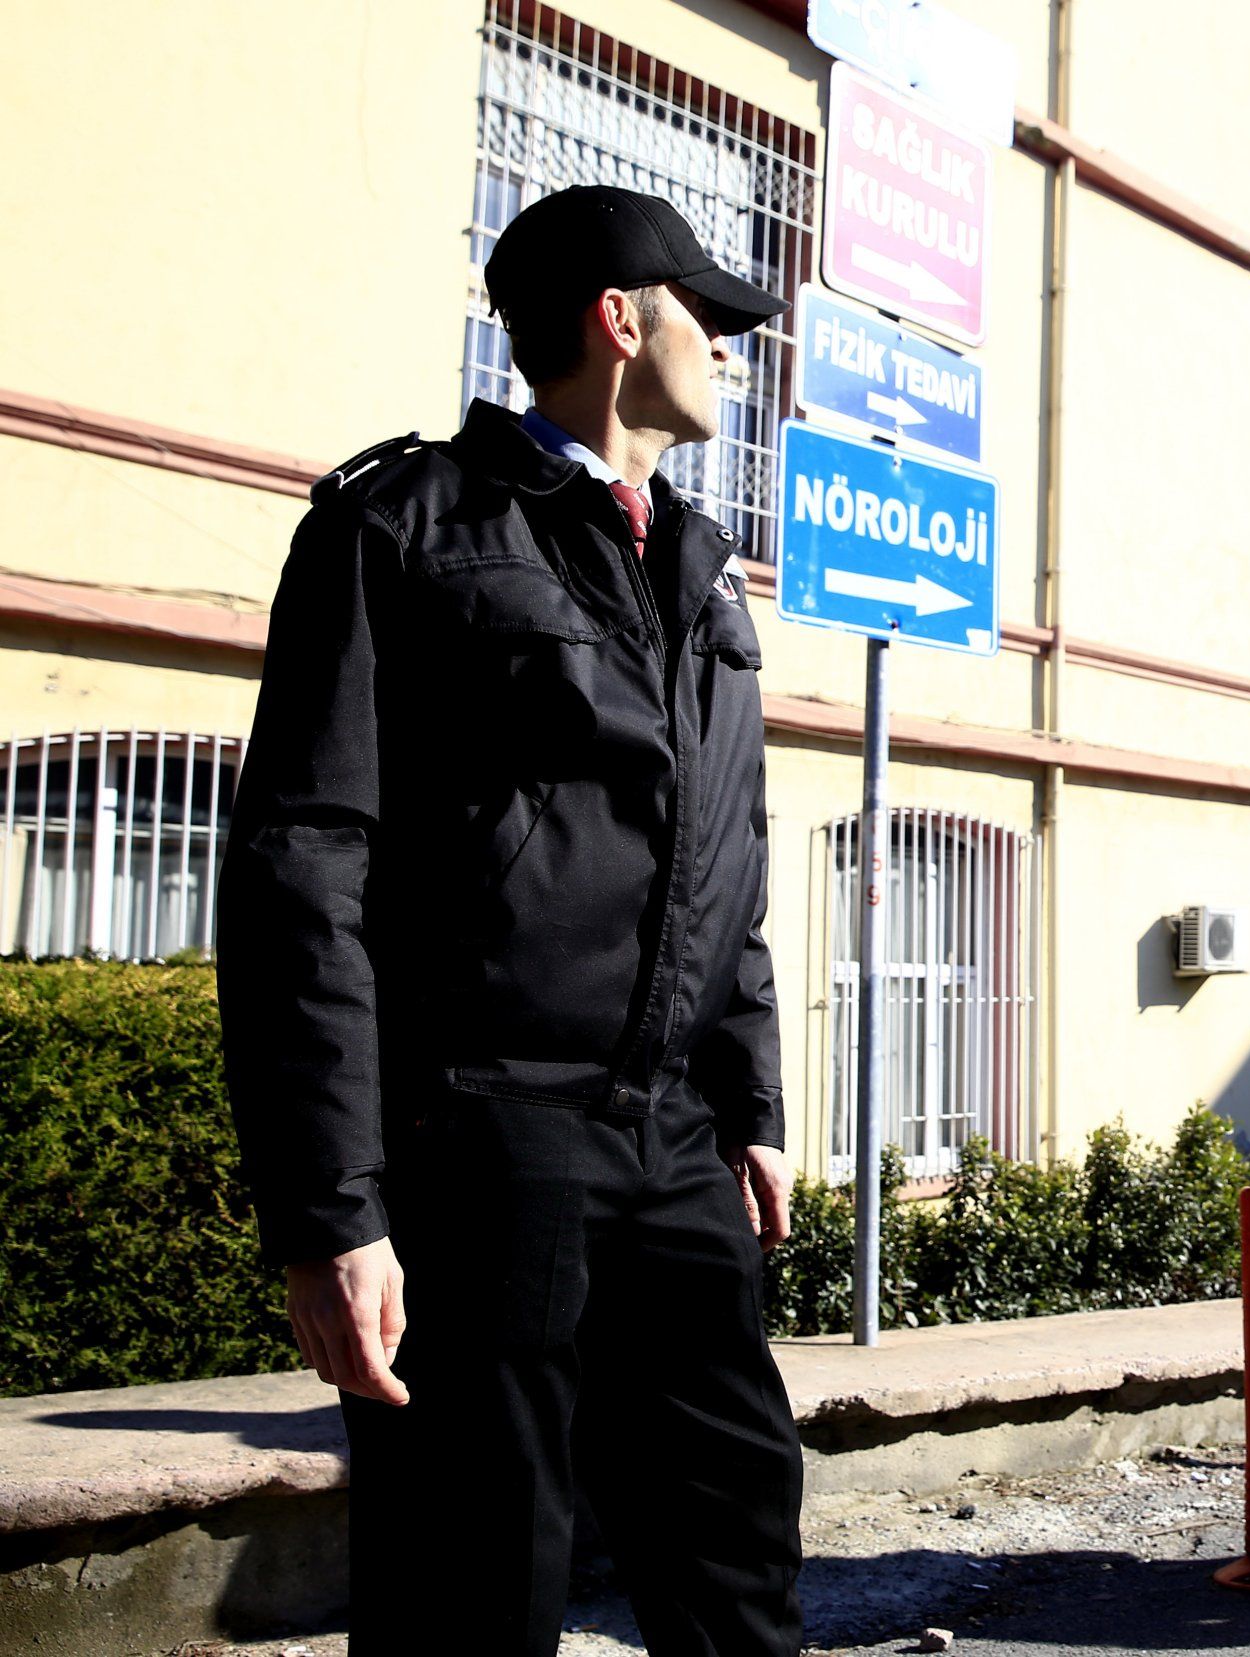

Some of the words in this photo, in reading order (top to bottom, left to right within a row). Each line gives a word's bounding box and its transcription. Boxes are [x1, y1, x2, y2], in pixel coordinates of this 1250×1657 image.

[851, 102, 976, 204] SAĞLIK
[841, 163, 979, 267] KURULU
[814, 316, 888, 385] FİZİK
[891, 347, 976, 419] TEDAVİ
